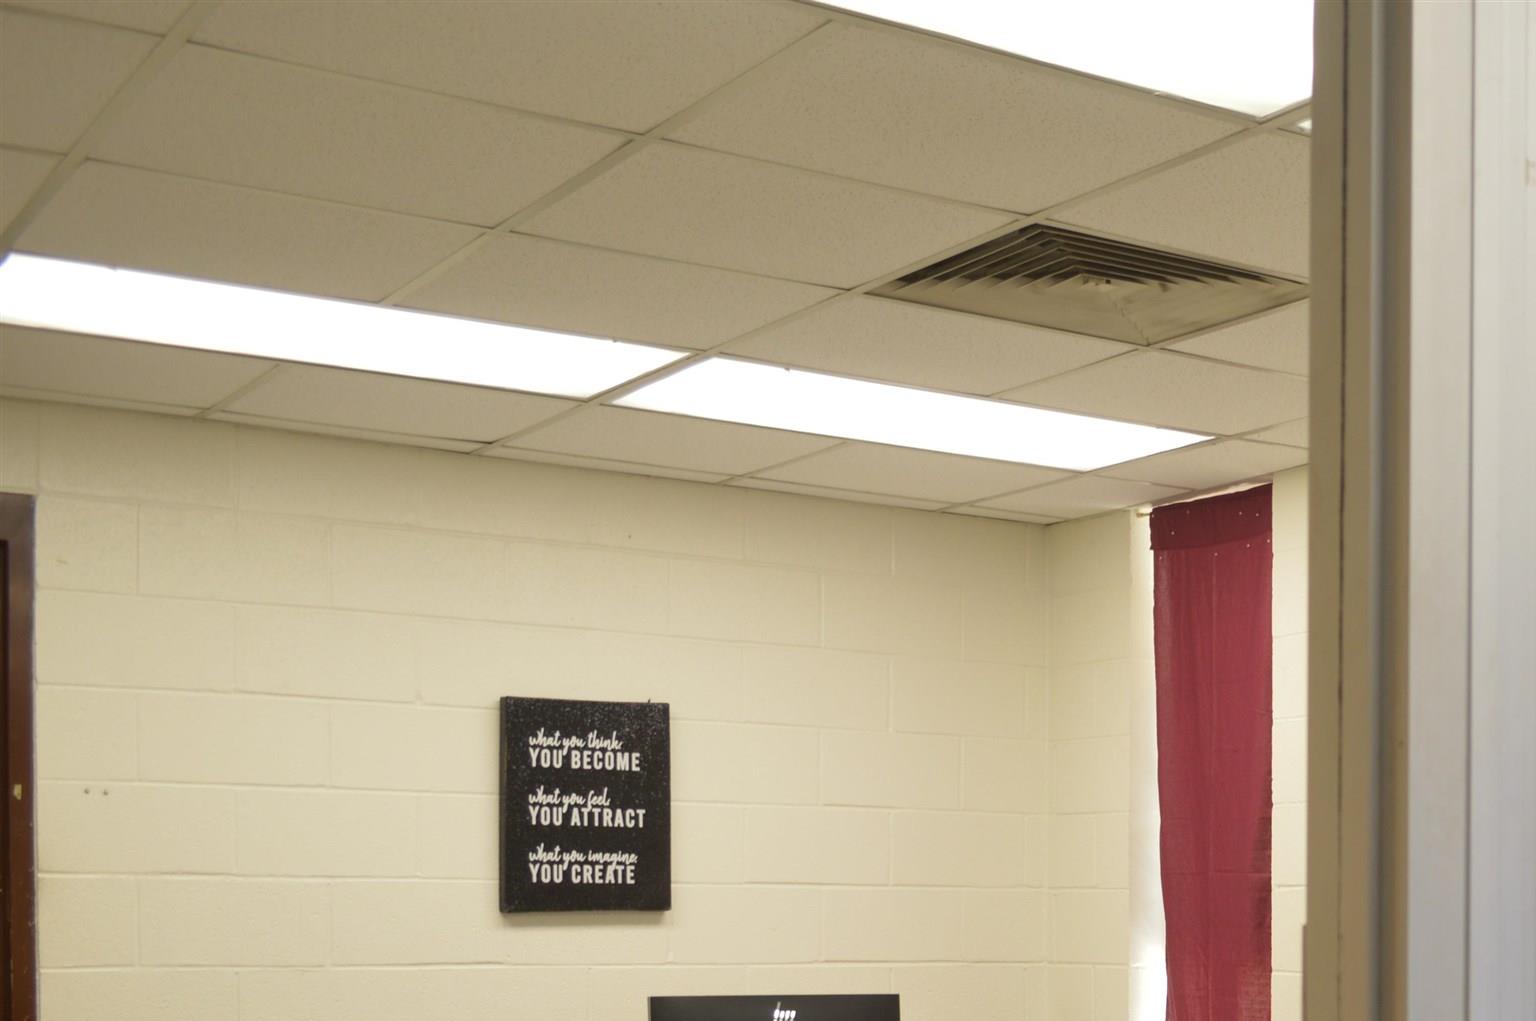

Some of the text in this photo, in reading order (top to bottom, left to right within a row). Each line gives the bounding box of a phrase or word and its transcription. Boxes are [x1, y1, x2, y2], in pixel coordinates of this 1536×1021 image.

[528, 727, 561, 747] what
[562, 734, 586, 756] you
[528, 748, 641, 771] YOU BECOME
[528, 785, 561, 805] what
[562, 792, 586, 814] you
[528, 805, 646, 828] YOU ATTRACT
[528, 842, 561, 863] what
[562, 850, 586, 871] you
[528, 863, 636, 884] YOU CREATE
